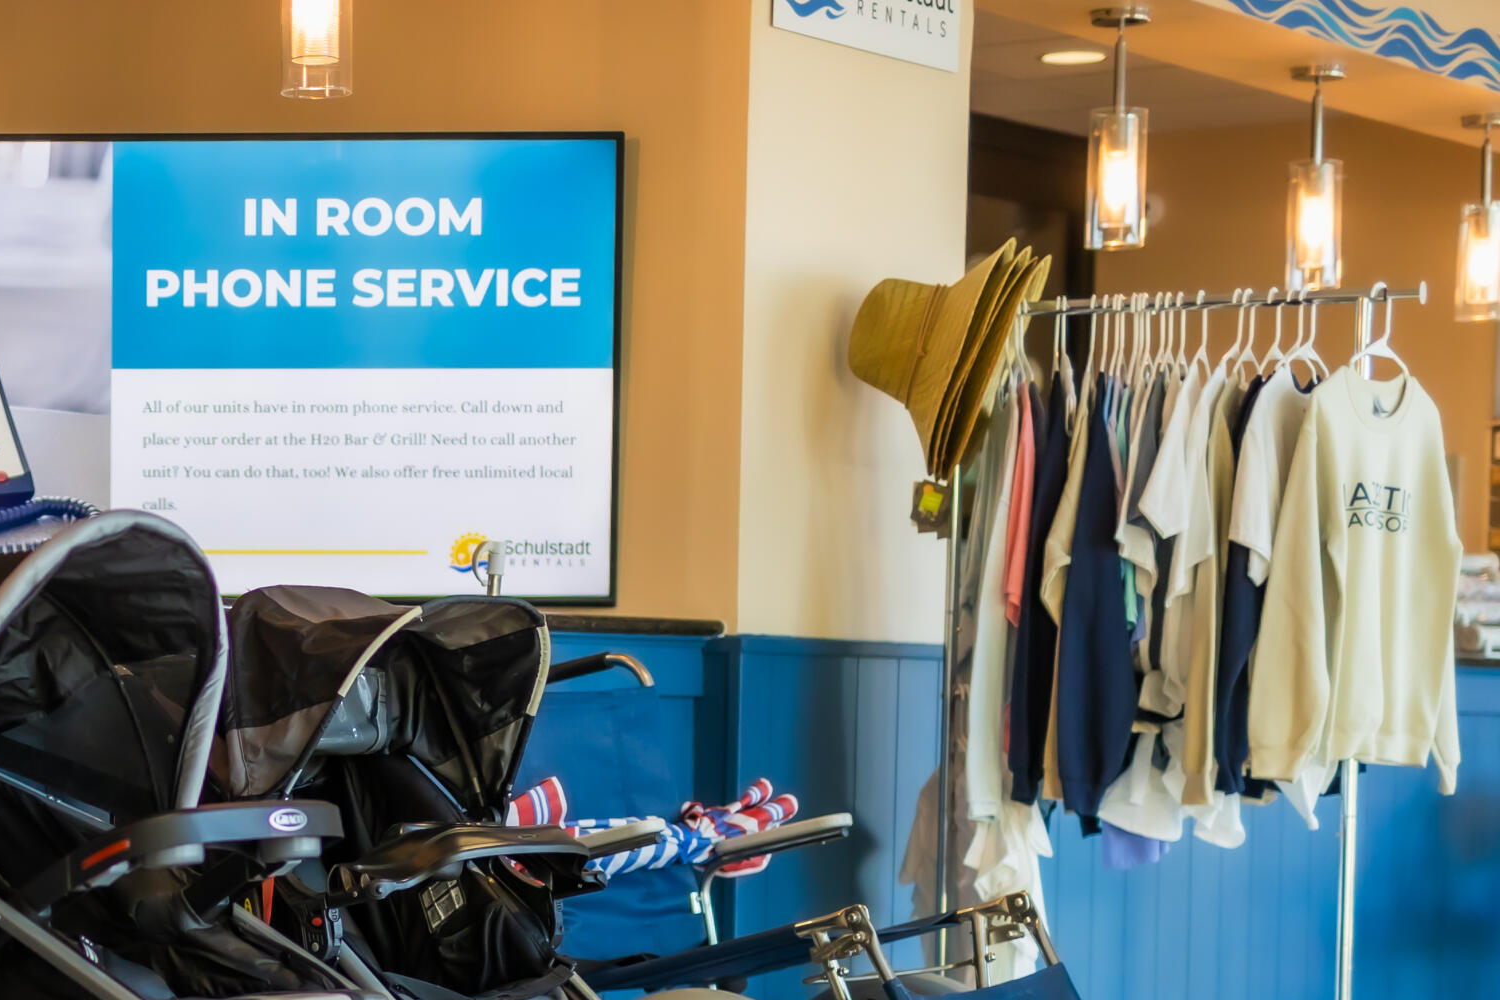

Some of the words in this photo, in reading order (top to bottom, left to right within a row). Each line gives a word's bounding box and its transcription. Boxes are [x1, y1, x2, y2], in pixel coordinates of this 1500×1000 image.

[857, 0, 947, 38] RENTALS
[244, 197, 298, 236] IN
[316, 196, 483, 237] ROOM
[146, 268, 337, 308] PHONE
[352, 267, 581, 308] SERVICE
[142, 400, 162, 414] All
[166, 400, 182, 414] of
[183, 403, 210, 414] our
[212, 400, 250, 414] units
[253, 400, 288, 414] have
[291, 400, 306, 414] in
[310, 403, 349, 414] room
[352, 400, 398, 417] phone
[401, 400, 457, 414] service.
[460, 400, 488, 414] Call
[492, 400, 533, 414] down
[536, 400, 564, 414] and
[142, 432, 180, 449] place
[183, 436, 217, 449] your
[221, 432, 261, 446] order
[264, 434, 278, 446] at
[282, 432, 306, 446] the
[344, 433, 368, 446] Bar
[372, 432, 387, 446] &
[390, 432, 427, 446] Grill!
[431, 432, 468, 446] Need
[471, 434, 487, 446] to
[490, 432, 515, 446] call
[518, 432, 577, 446] another
[142, 465, 180, 479] unit?
[183, 466, 212, 479] You
[214, 467, 241, 479] can
[243, 465, 263, 479] do
[265, 465, 300, 480] that,
[302, 465, 331, 479] too!
[334, 466, 358, 479] We
[360, 465, 390, 479] also
[393, 465, 429, 479] offer
[432, 465, 461, 479] free
[464, 465, 536, 479] unlimited
[539, 465, 573, 479] local
[142, 498, 178, 511] calls.
[505, 540, 591, 555] Schulstadt
[510, 558, 586, 567] RENTALS
